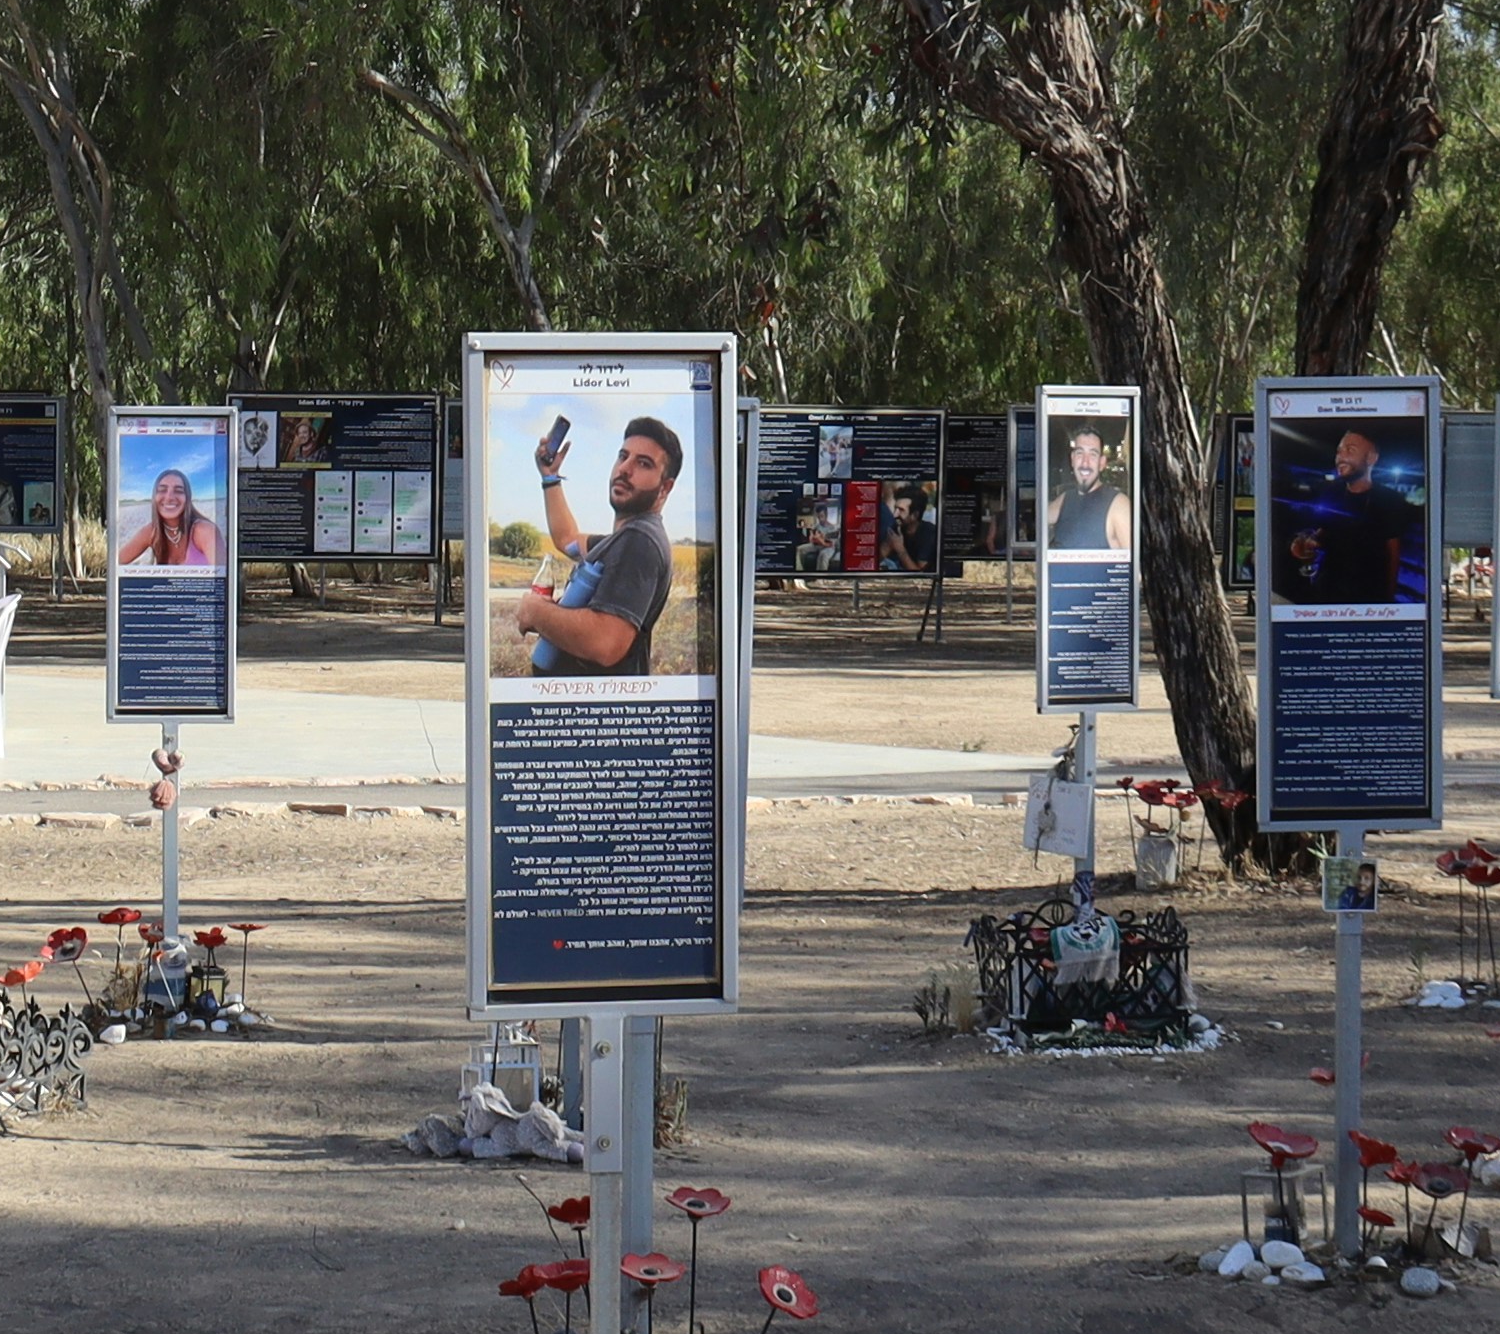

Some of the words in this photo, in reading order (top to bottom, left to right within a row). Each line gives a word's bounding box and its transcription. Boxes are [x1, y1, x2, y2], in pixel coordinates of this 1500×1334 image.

[577, 362, 594, 373] לוי
[595, 362, 625, 373] לידור
[572, 377, 603, 388] Lidor
[605, 377, 630, 388] Levi
